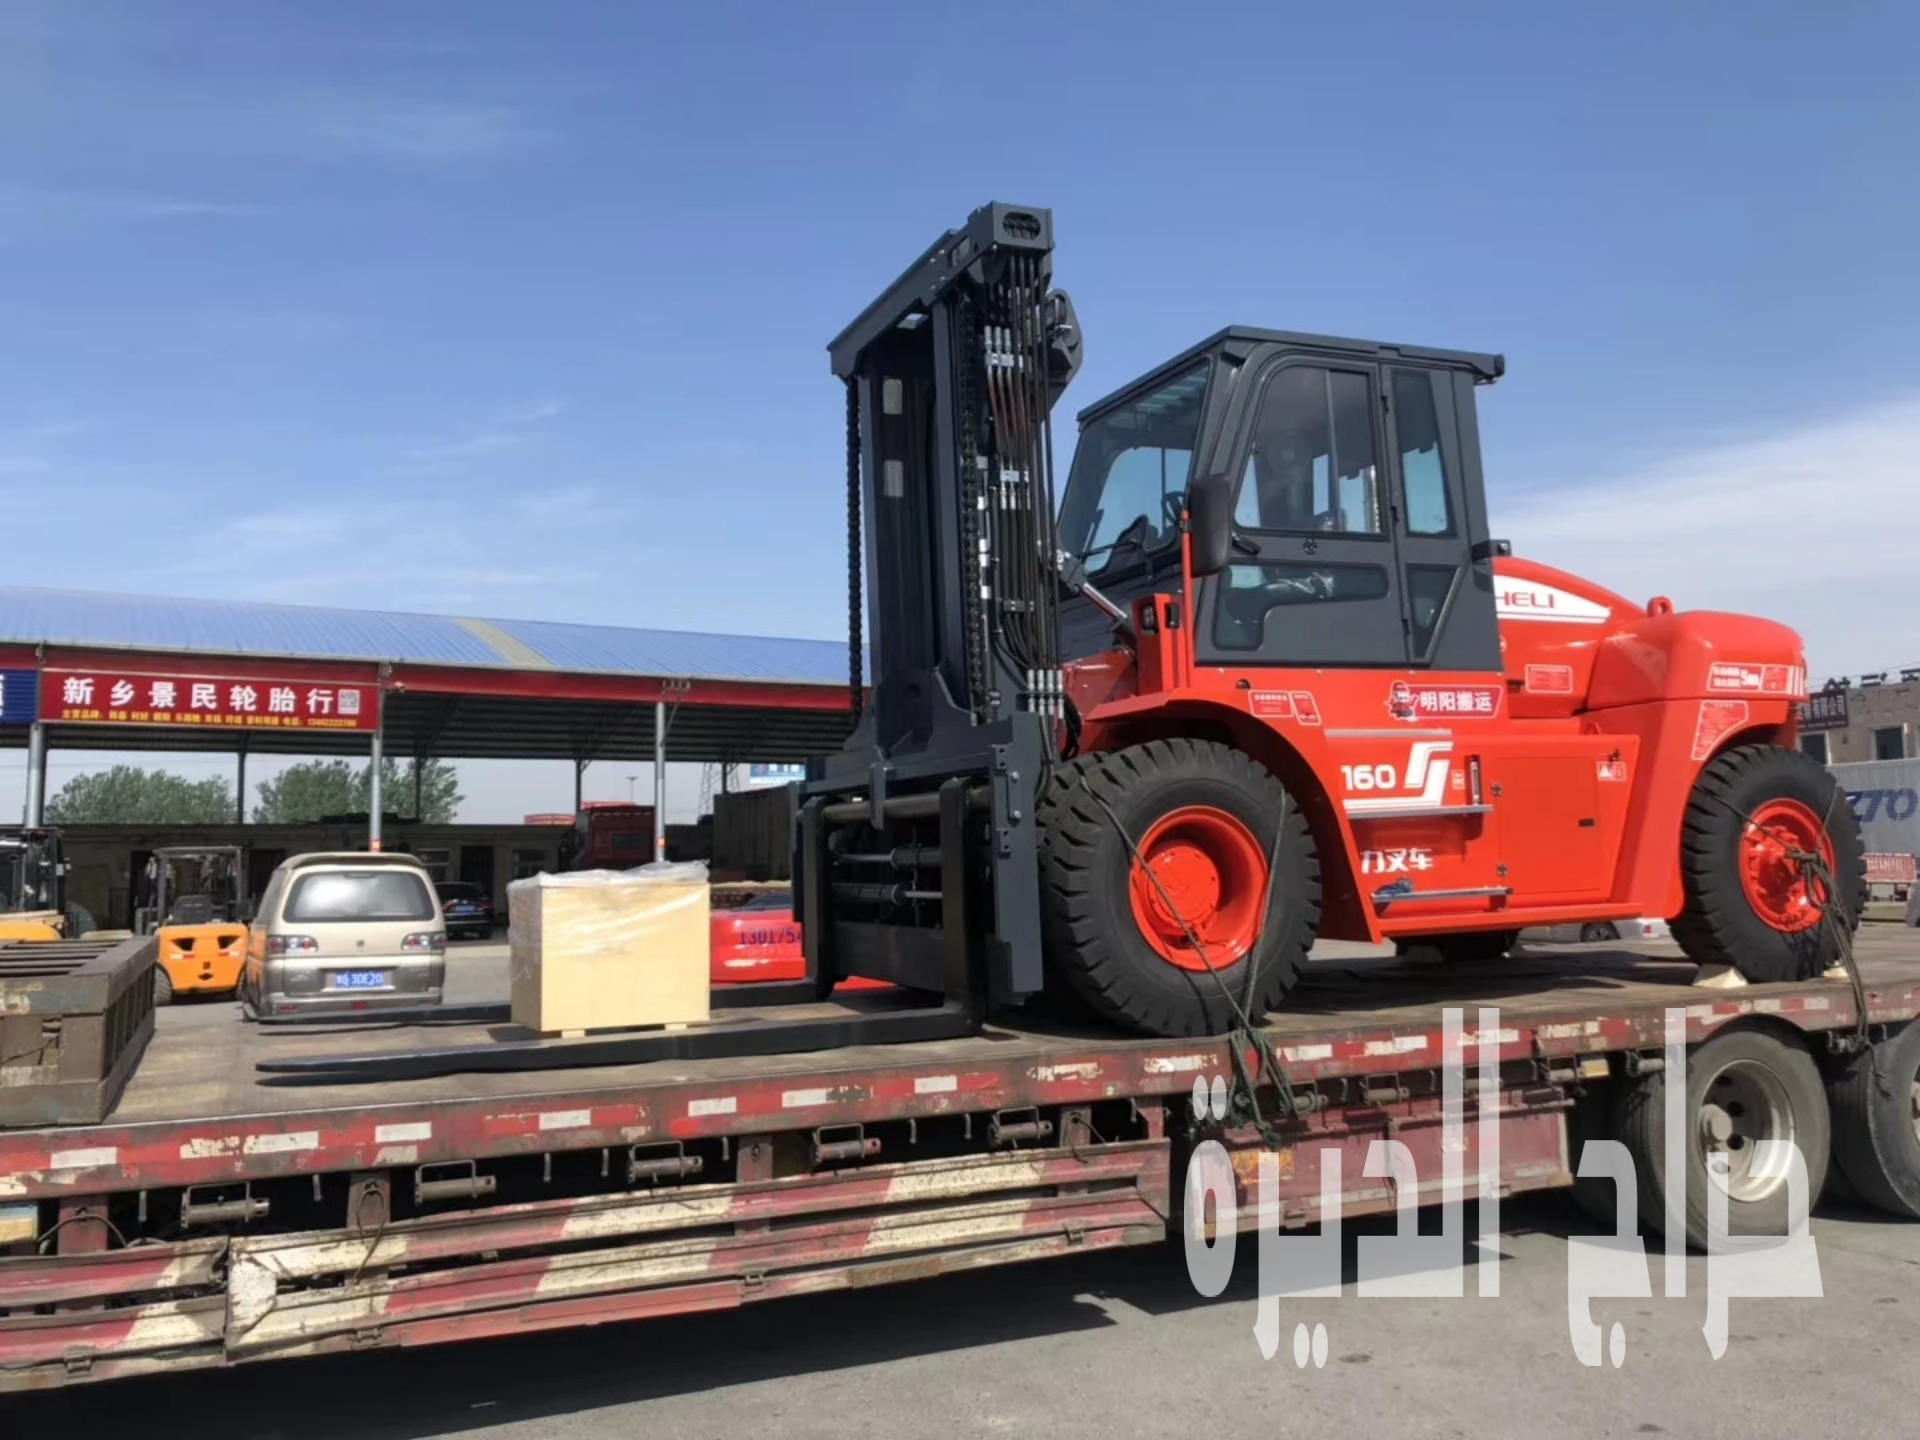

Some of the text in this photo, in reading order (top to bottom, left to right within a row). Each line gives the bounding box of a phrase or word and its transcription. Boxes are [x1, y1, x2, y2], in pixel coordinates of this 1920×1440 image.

[63, 676, 334, 714] 新乡景民轮胎行
[1420, 691, 1492, 712] 明阳搬运
[1340, 764, 1396, 791] 160
